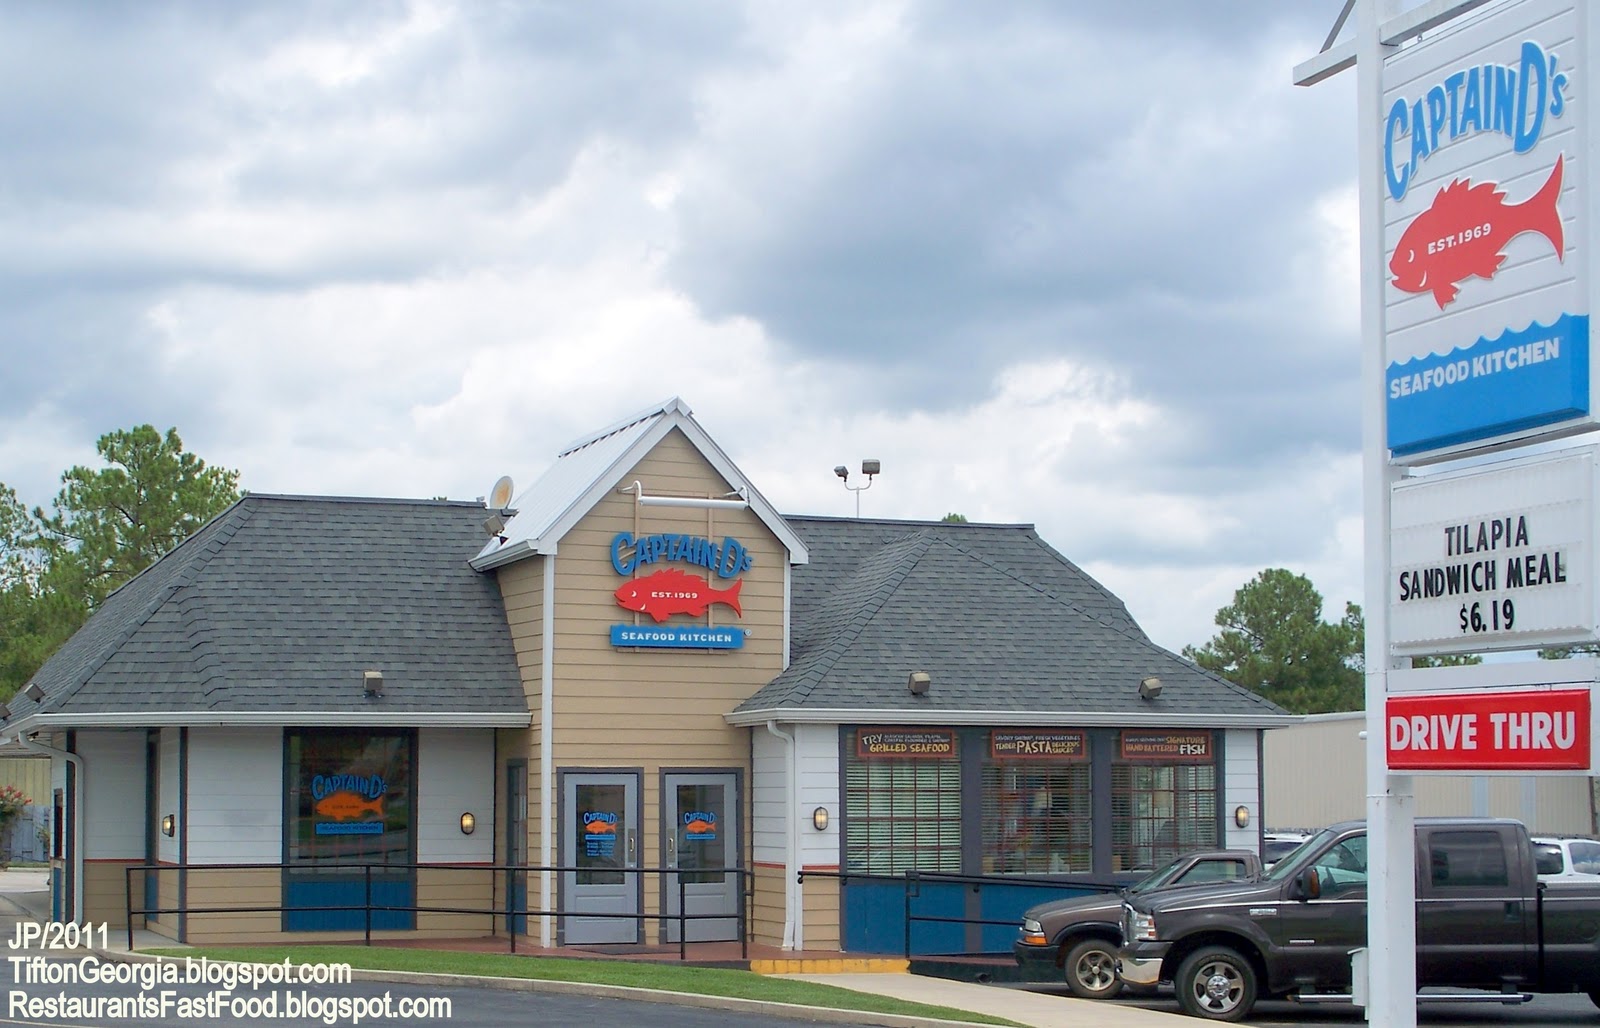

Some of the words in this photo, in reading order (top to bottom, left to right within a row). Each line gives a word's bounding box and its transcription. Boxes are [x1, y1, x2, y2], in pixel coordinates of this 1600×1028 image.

[1385, 64, 1517, 201] CAPTAIN
[1389, 358, 1470, 399] SEAFOOD
[1472, 337, 1560, 379] KITCHEN
[1445, 515, 1529, 556] TILAPIA
[610, 531, 718, 576] CAPTAIN
[1400, 560, 1496, 601] SANDWICH
[1506, 552, 1566, 589] MEAL
[1460, 599, 1515, 633] $6.19
[621, 632, 675, 641] SEAFOOD
[680, 633, 732, 642] KITCHEN
[862, 733, 883, 745] TRY
[1165, 736, 1206, 744] SIGNATURE
[1390, 714, 1477, 751] DRIVE
[1490, 711, 1576, 750] THRU
[869, 743, 907, 752] GRILLED
[910, 743, 950, 752] SEAFOOD
[1016, 740, 1053, 754] PASTA
[1179, 744, 1205, 755] FISH
[312, 774, 369, 800] CAPTAIN
